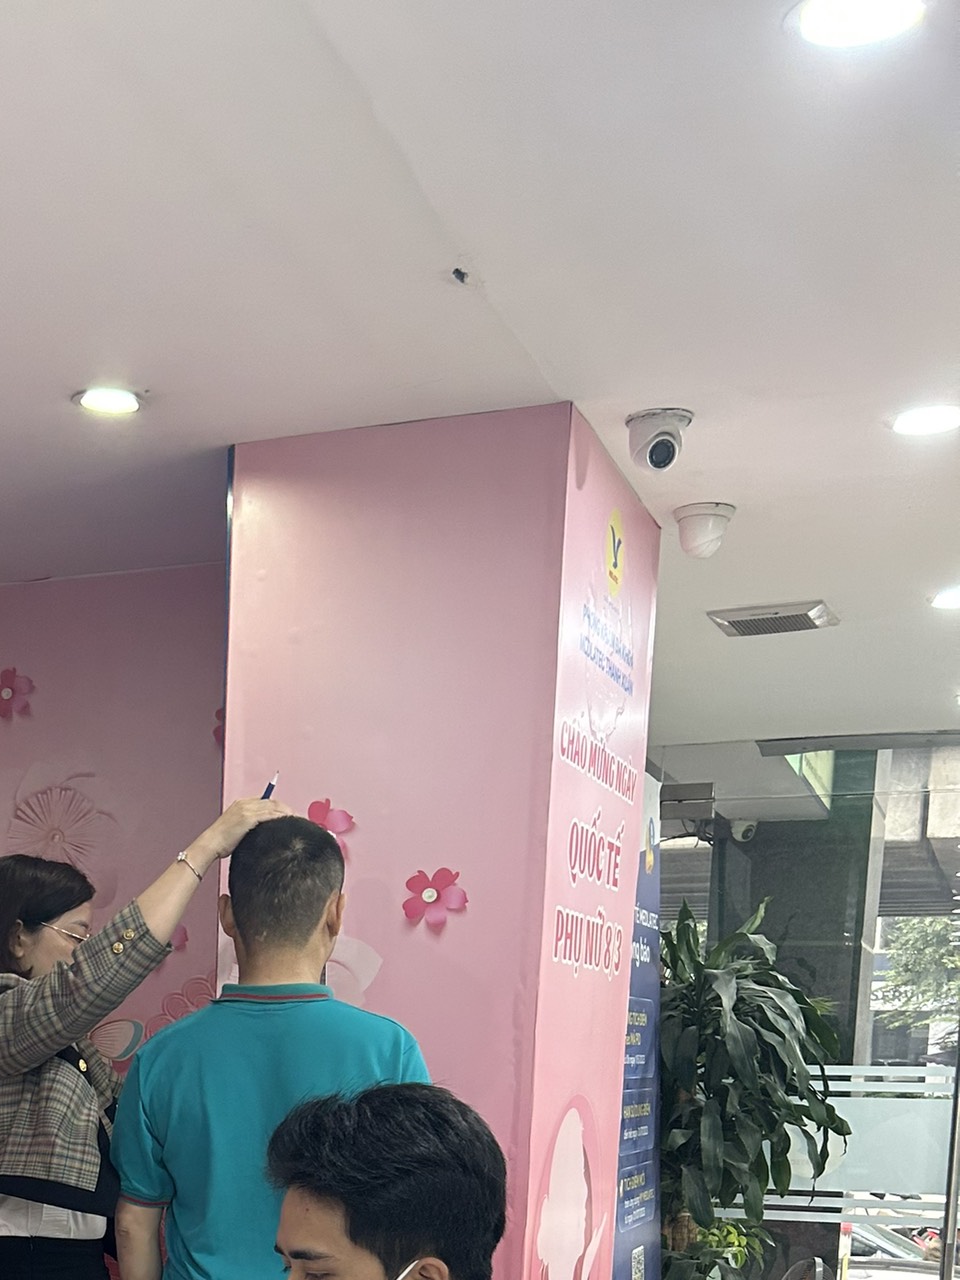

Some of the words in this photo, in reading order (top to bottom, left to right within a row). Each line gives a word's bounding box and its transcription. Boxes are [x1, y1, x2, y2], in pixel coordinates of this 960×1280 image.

[615, 756, 637, 803] NGÀY
[569, 810, 605, 885] QUỐC
[606, 823, 625, 890] TẾ
[554, 908, 583, 975] PHỤ
[584, 909, 605, 968] NỮ
